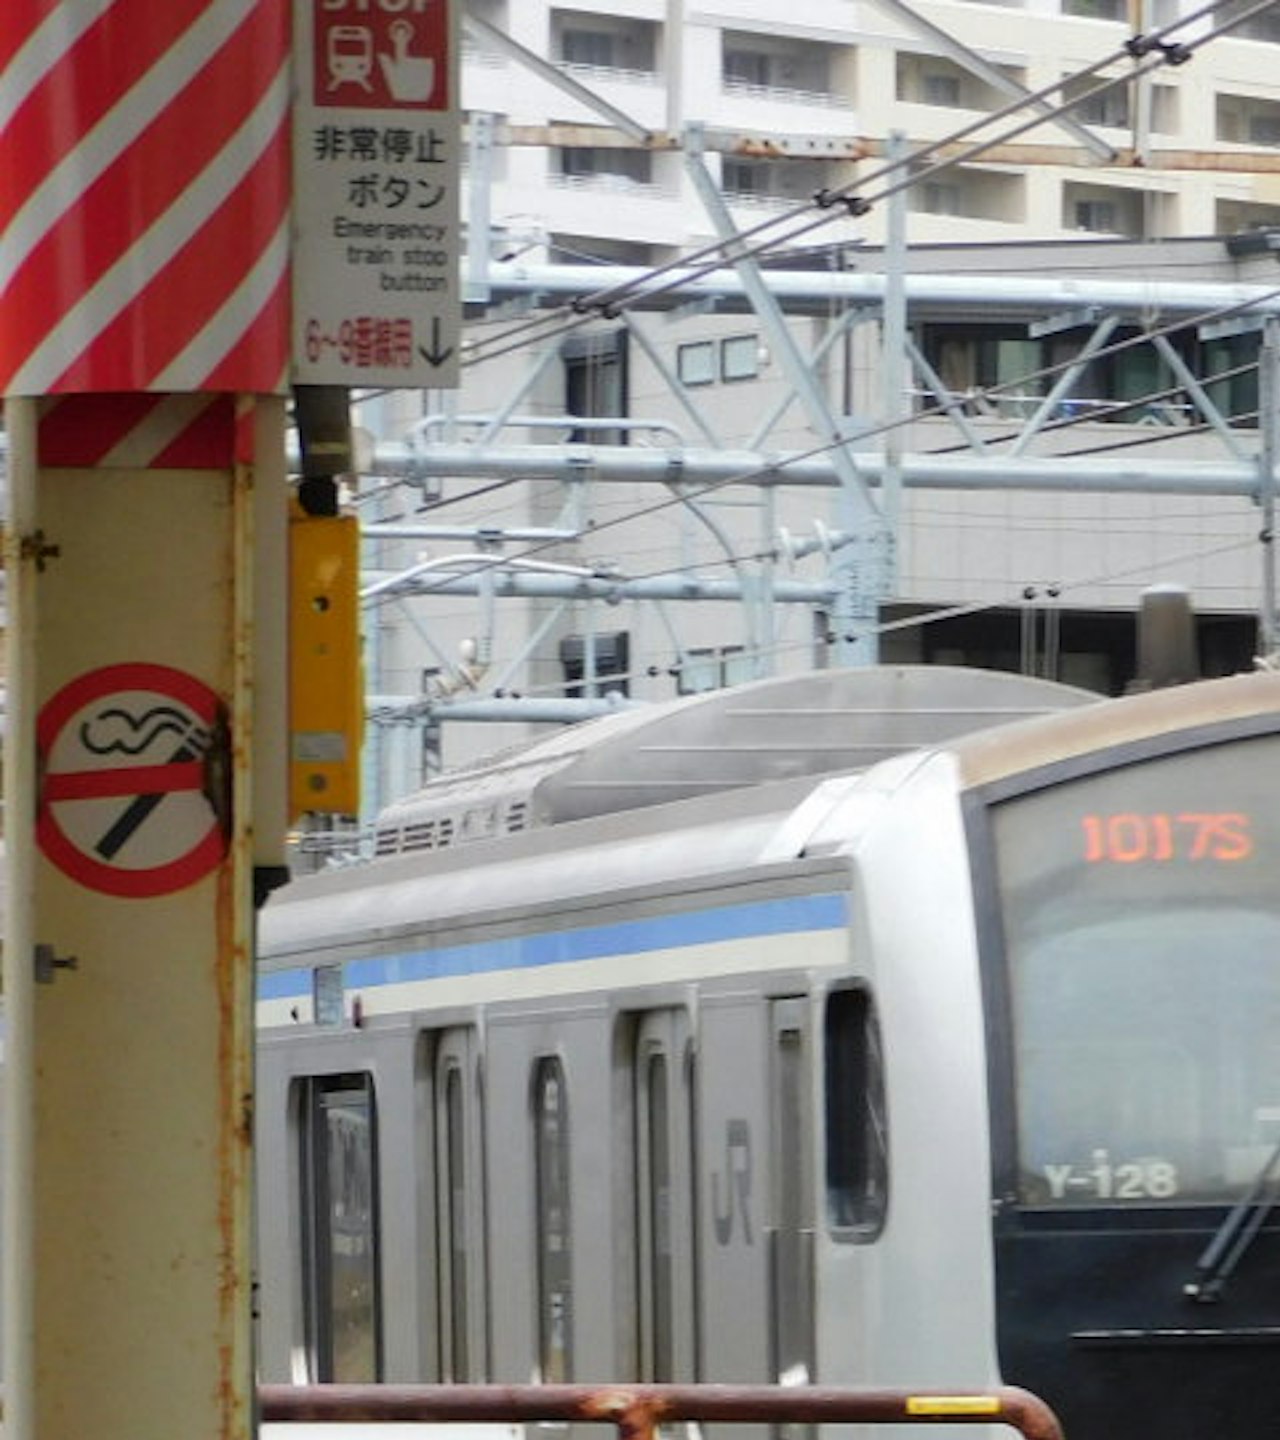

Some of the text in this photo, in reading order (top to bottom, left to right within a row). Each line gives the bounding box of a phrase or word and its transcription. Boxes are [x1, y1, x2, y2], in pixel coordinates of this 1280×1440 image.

[313, 126, 446, 162] 非常停止
[348, 173, 446, 208] ボタン
[333, 216, 446, 241] Emergency
[347, 246, 447, 266] train stop
[381, 272, 447, 292] button
[1081, 812, 1253, 862] 1017S
[711, 1118, 755, 1247] JR
[1044, 1162, 1178, 1199] Y-128
